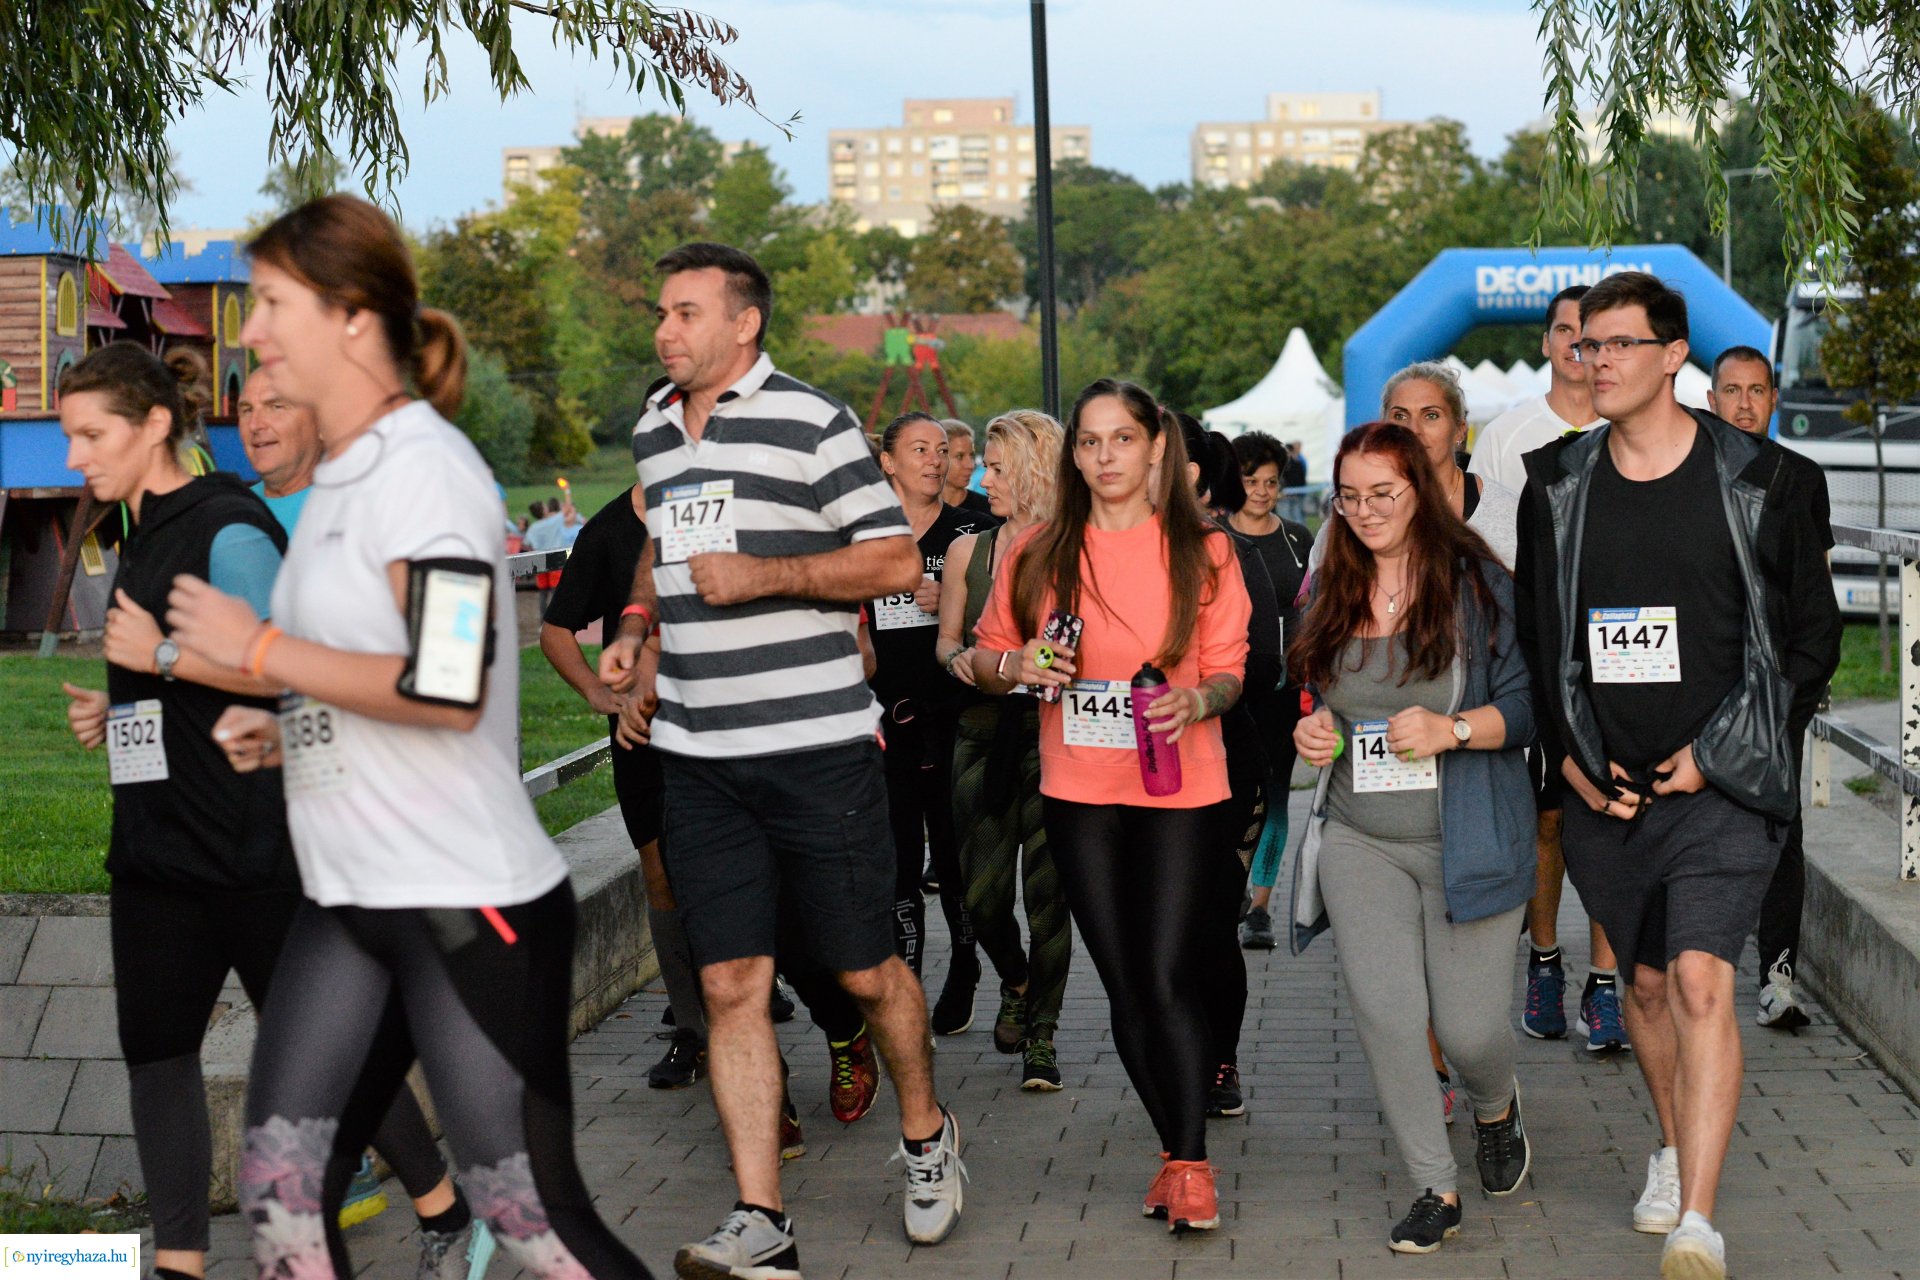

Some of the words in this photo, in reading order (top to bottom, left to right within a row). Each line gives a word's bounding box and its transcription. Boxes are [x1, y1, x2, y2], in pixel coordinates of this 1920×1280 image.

[669, 499, 726, 528] 1477
[1598, 625, 1669, 650] 1447
[1069, 693, 1133, 719] 1445
[112, 719, 156, 749] 1502
[1358, 736, 1397, 761] 14
